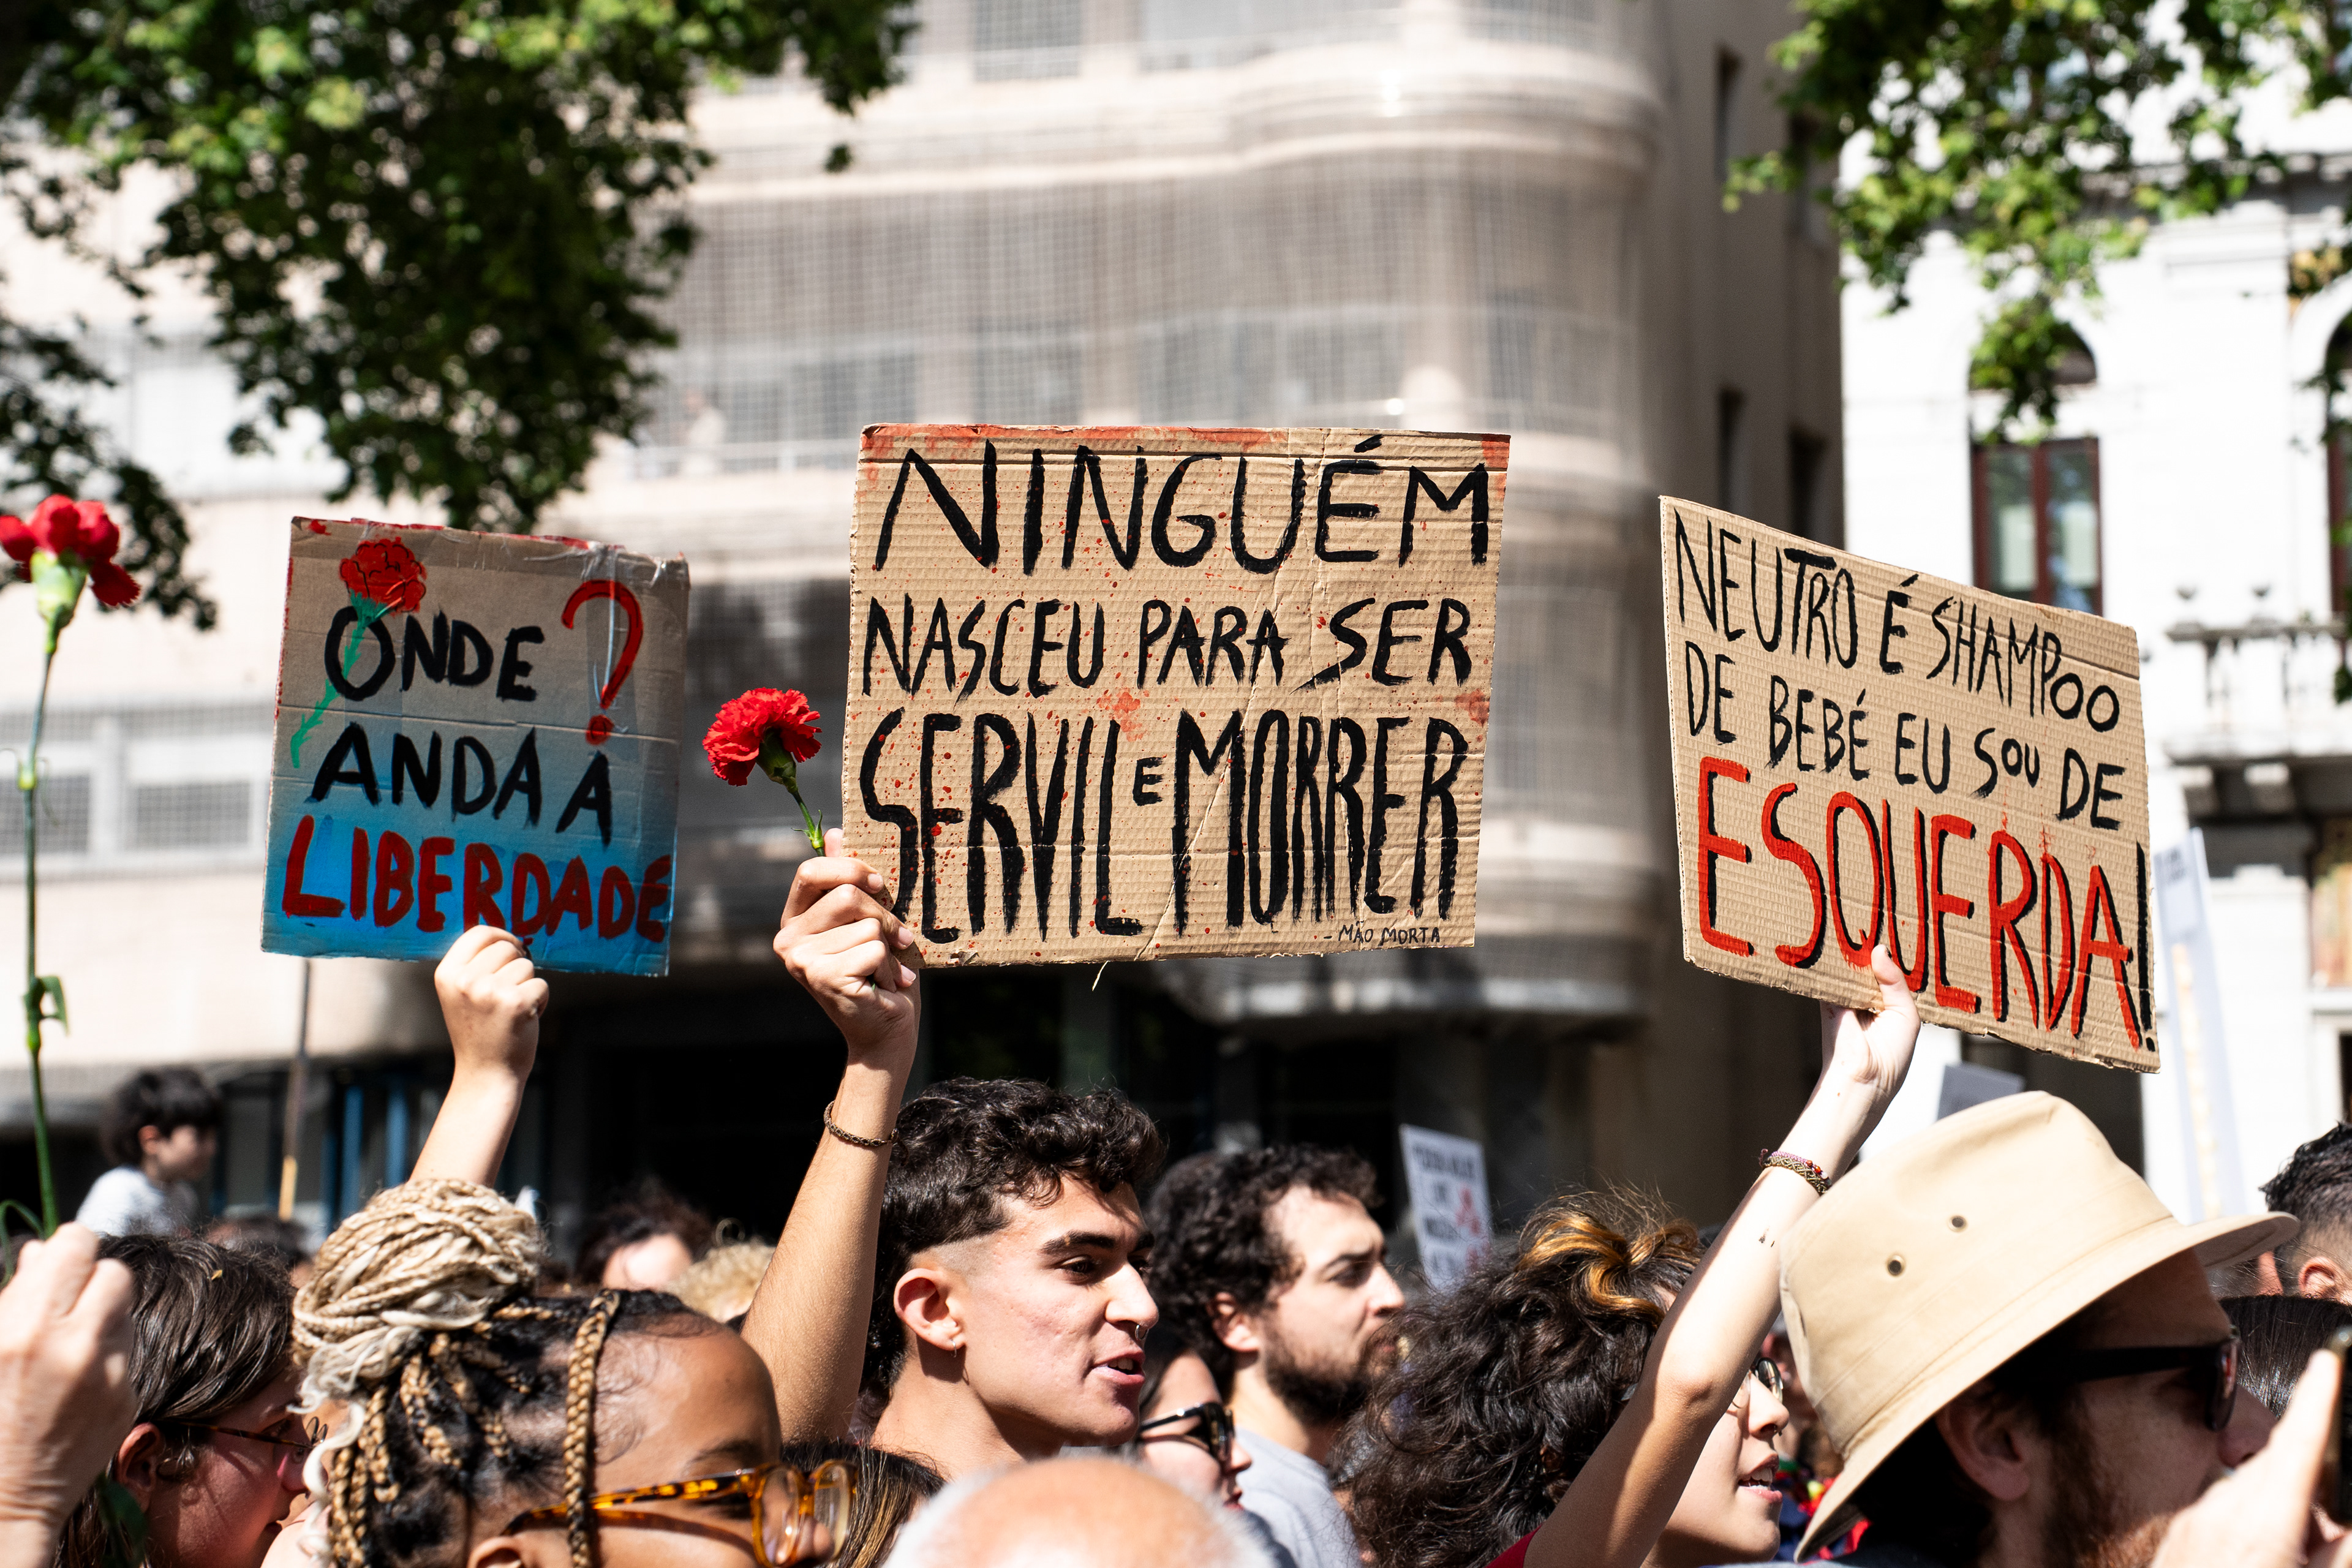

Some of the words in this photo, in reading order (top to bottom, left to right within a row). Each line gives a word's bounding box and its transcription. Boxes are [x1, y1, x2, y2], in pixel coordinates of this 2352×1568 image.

[875, 434, 1489, 576] NINGUÉM
[324, 603, 544, 701] ONDE
[862, 593, 1104, 706] NASCEU
[1137, 599, 1289, 690] PARA
[1289, 598, 1471, 695] SER
[1673, 507, 1858, 669] NEUTRO
[1879, 573, 1920, 675] É
[1926, 595, 2120, 733] SHAMPOO
[304, 720, 543, 828] ANDA
[556, 750, 612, 853] A
[1684, 641, 1737, 745] DE
[1765, 674, 1872, 782] BEBÉ
[1894, 712, 1951, 794] EU
[1970, 727, 2041, 798] SOU
[2054, 747, 2127, 830] DE
[282, 814, 671, 943] LIBERDADE
[859, 707, 1144, 943] SERVIL
[1133, 756, 1164, 806] E
[1172, 708, 1469, 938] MORRER
[1338, 921, 1374, 944] MÃO
[1380, 924, 1442, 946] MORTA
[1697, 756, 2155, 1052] ESQUERDA!
